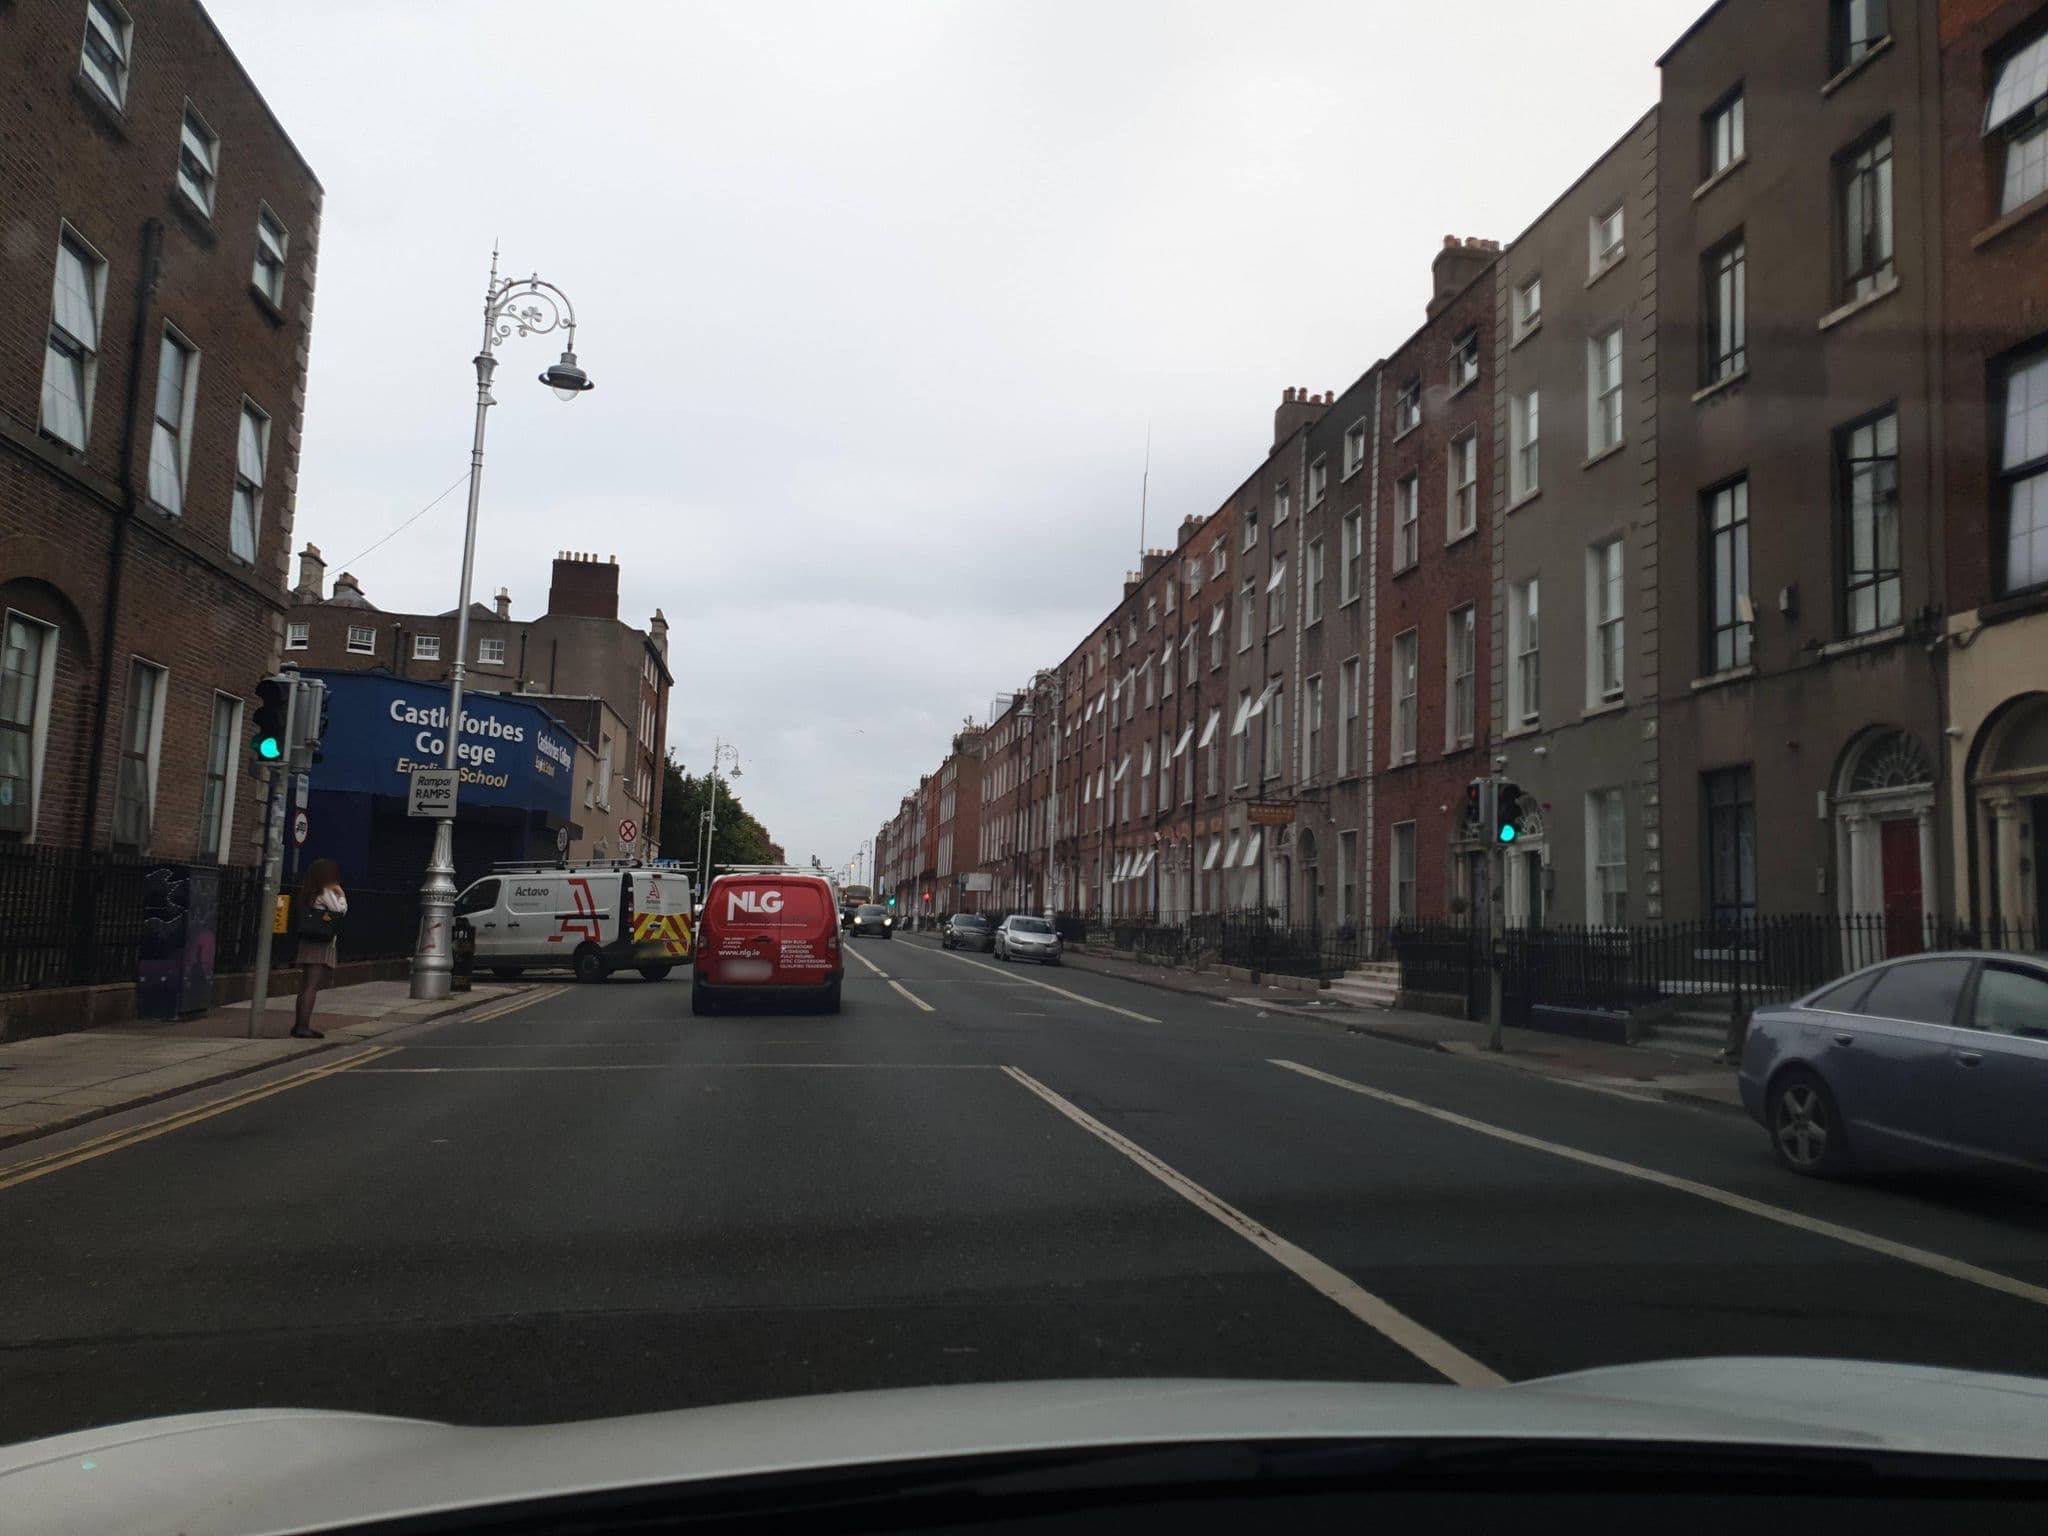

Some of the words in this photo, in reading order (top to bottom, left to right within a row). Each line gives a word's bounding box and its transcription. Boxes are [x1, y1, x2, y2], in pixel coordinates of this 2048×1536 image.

[416, 731, 496, 767] Coege
[460, 767, 509, 787] School
[415, 788, 451, 799] RAMPS
[514, 886, 550, 897] Actavo
[727, 891, 784, 921] NLG
[718, 948, 761, 958] www.nlg.ie
